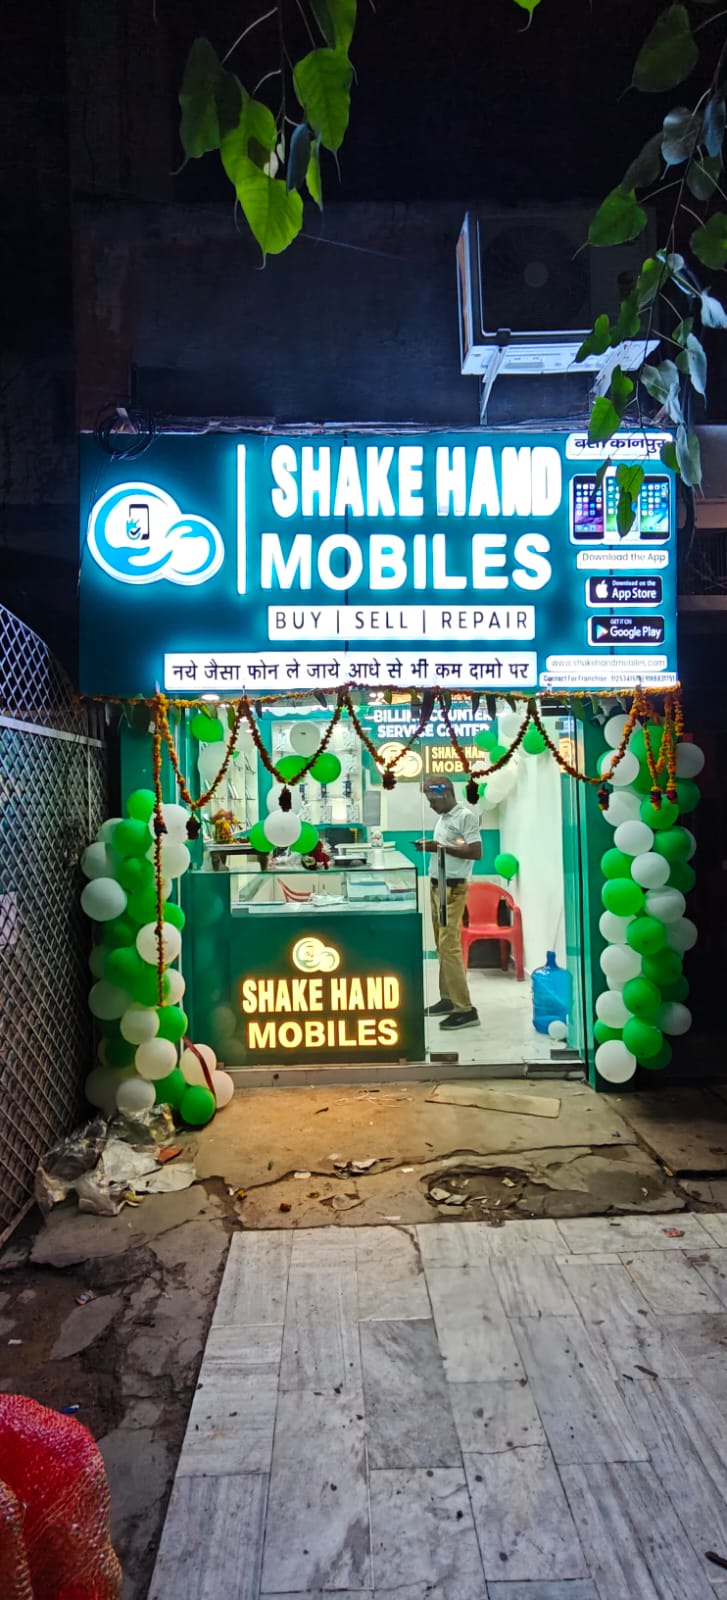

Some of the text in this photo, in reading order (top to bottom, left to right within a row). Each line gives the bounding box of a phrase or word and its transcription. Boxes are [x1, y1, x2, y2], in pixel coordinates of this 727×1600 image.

[271, 444, 562, 518] SHAKE HAND
[261, 533, 552, 590] MOBILES
[582, 552, 666, 564] Download the App
[611, 588, 657, 601] App Store
[276, 611, 322, 629] BUY
[355, 611, 408, 629] SELL
[441, 610, 528, 629] REPAIR
[610, 626, 662, 639] Google Play
[172, 657, 529, 681] नये जैसा फोन ले जाये आधे से भी कम दामो पर
[242, 976, 400, 1014] SHAKE HAND
[248, 1018, 399, 1049] MOBILES
